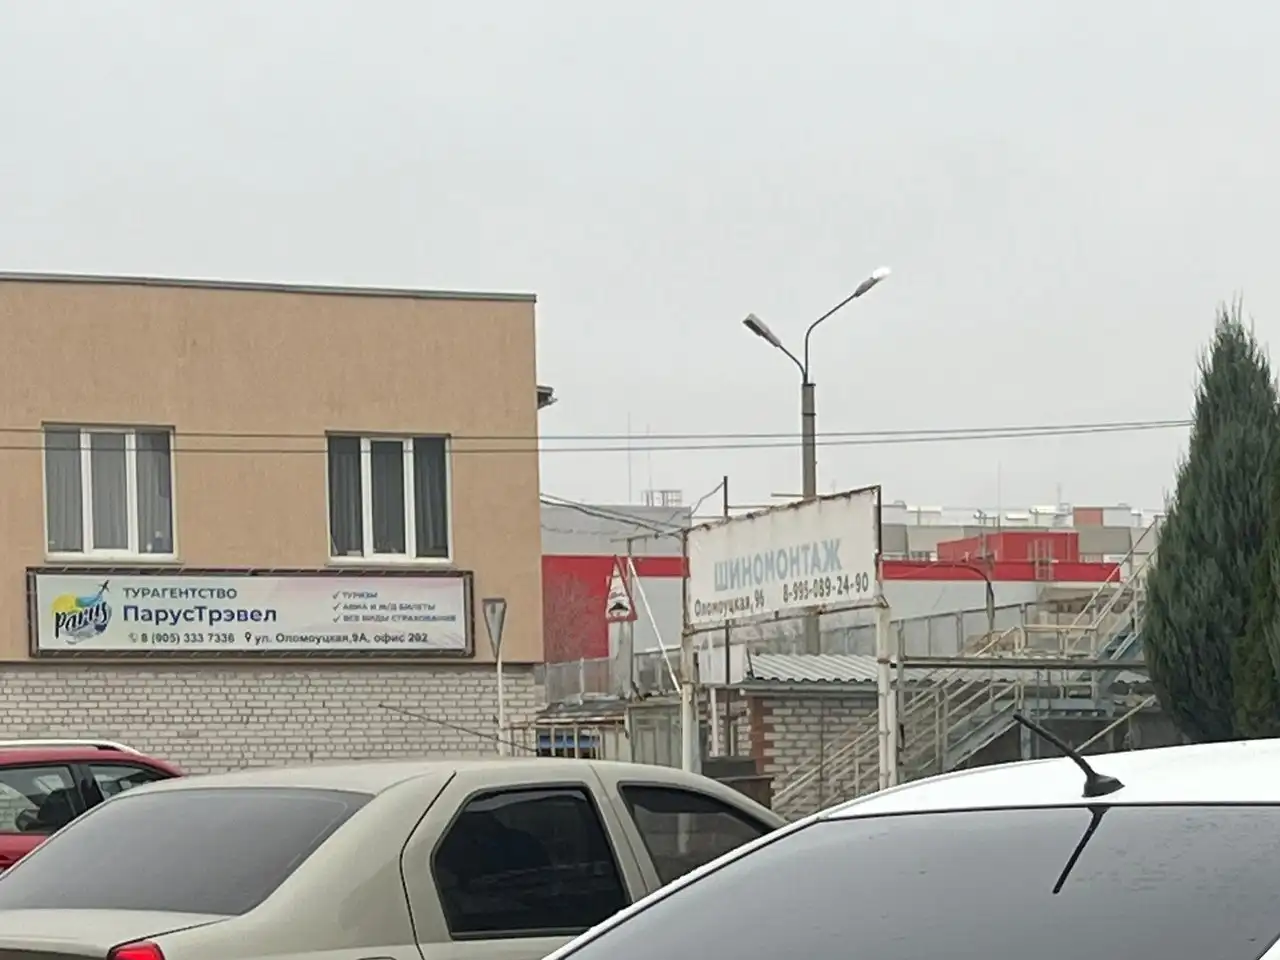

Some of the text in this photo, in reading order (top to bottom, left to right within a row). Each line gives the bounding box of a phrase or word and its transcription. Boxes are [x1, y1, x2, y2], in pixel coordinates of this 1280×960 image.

[714, 538, 843, 592] ШИНОМОНТАЖ
[122, 587, 238, 599] ТУРАГЕНТСТВО
[123, 605, 277, 625] ПарусТрэвел
[254, 634, 272, 645] ул.
[373, 633, 405, 644] офис
